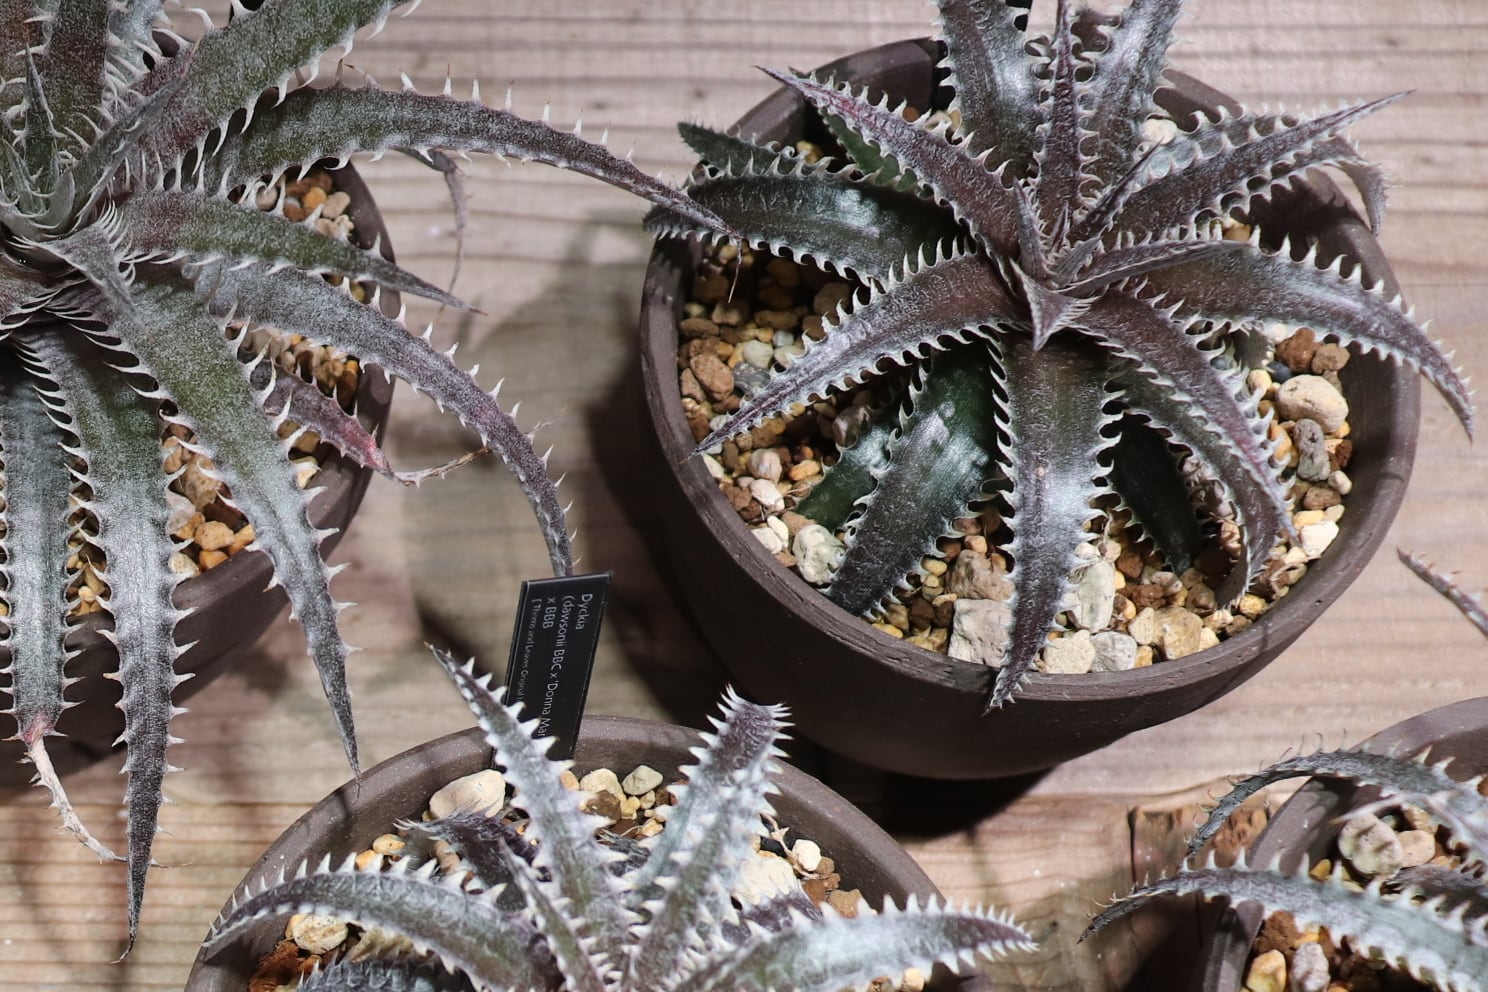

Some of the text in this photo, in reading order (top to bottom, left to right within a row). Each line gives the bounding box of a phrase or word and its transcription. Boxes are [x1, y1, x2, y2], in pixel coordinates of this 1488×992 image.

[542, 606, 557, 629] BBB
[556, 595, 575, 648] (dawsonii
[575, 593, 594, 630] Dyckia
[550, 649, 565, 671] BBC
[542, 680, 559, 716] 'Donna
[537, 717, 551, 737] Mar
